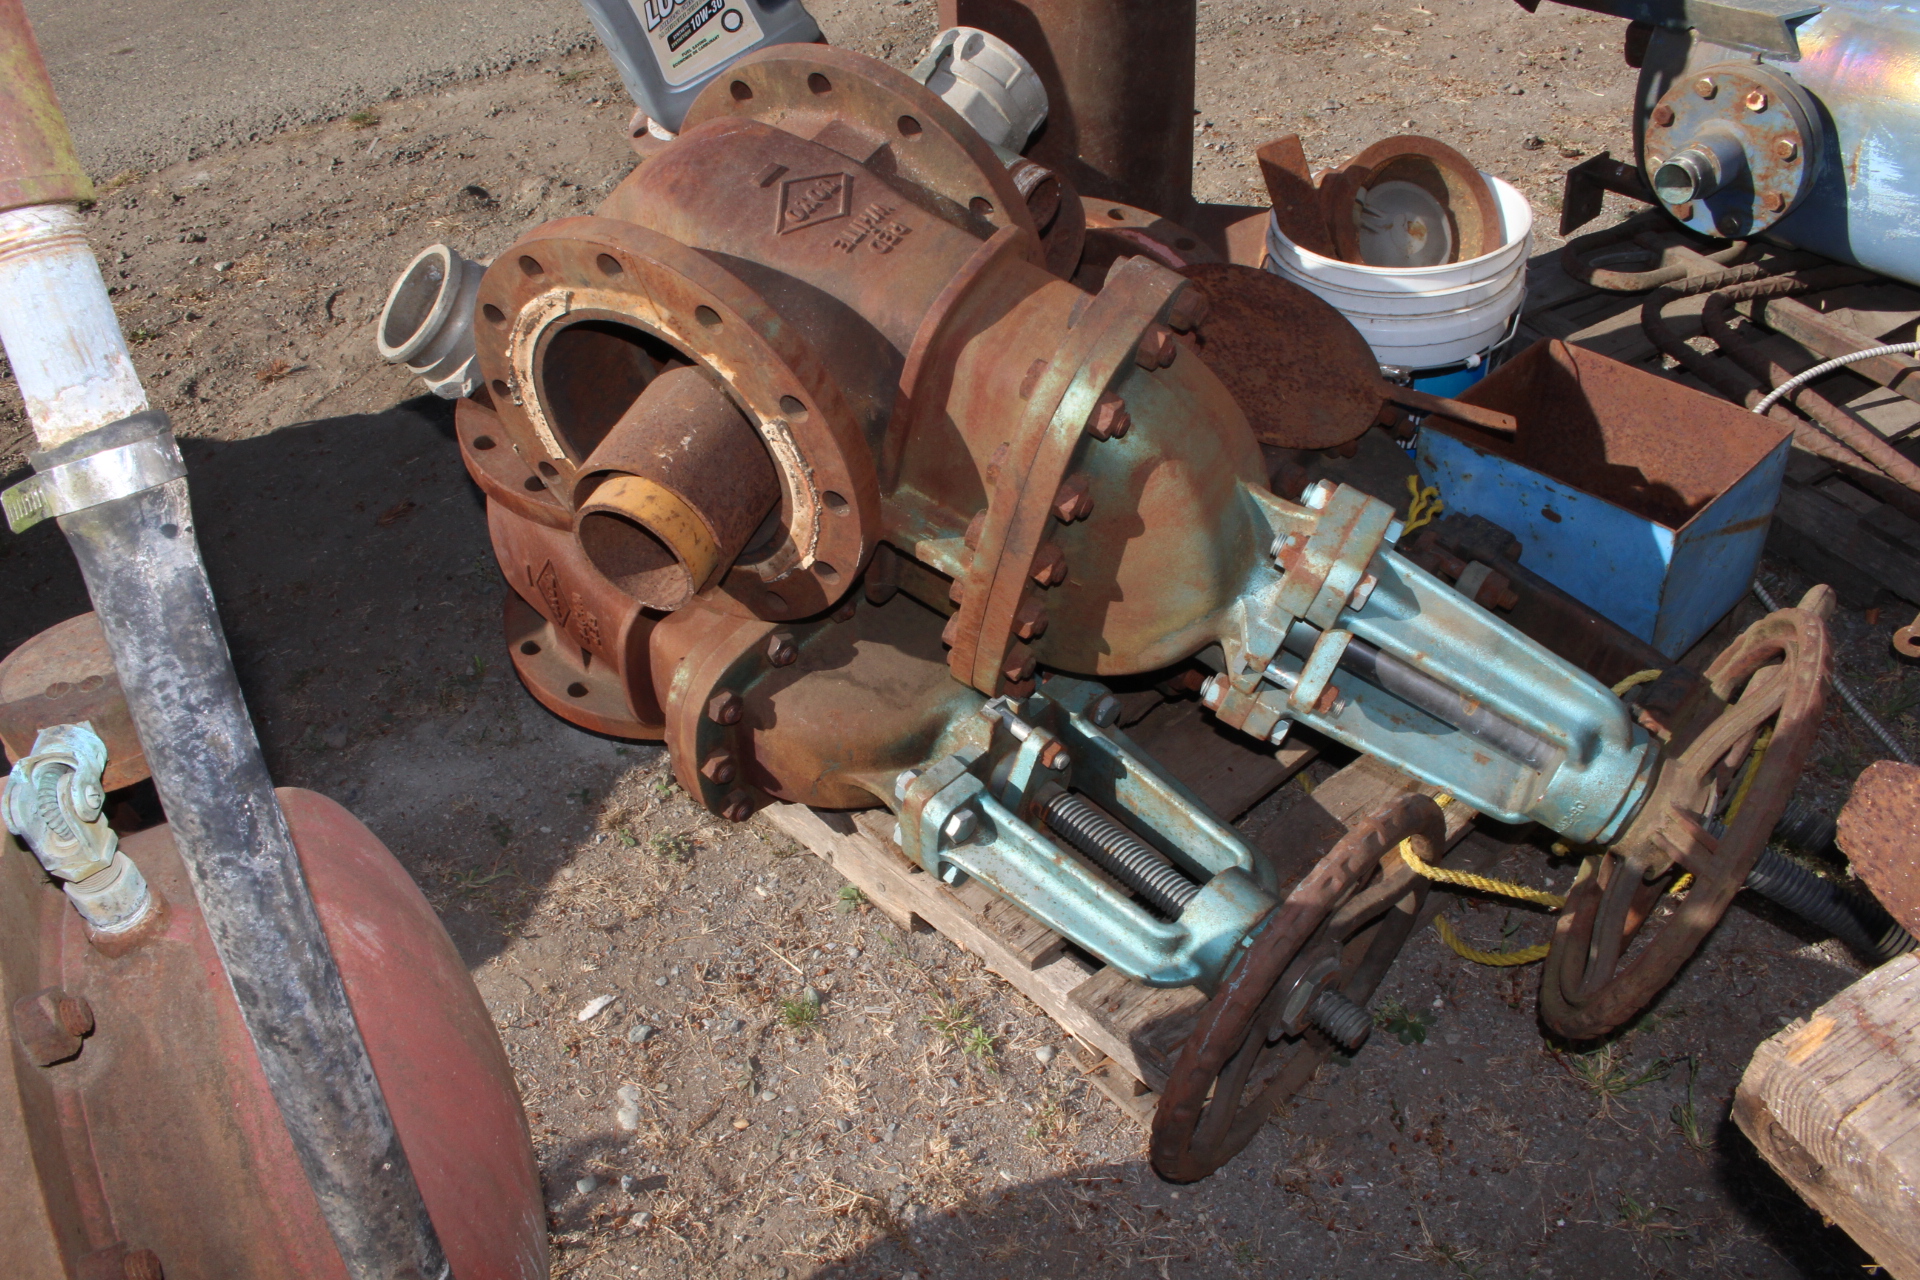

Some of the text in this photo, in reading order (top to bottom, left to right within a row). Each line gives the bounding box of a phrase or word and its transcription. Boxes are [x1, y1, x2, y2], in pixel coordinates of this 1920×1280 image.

[644, 0, 686, 32] LU
[690, 0, 723, 30] 10W-30
[681, 38, 707, 57] FUEL SAVING
[698, 34, 720, 51] CARBURANT
[831, 202, 896, 254] WHITE
[868, 220, 912, 254] RED
